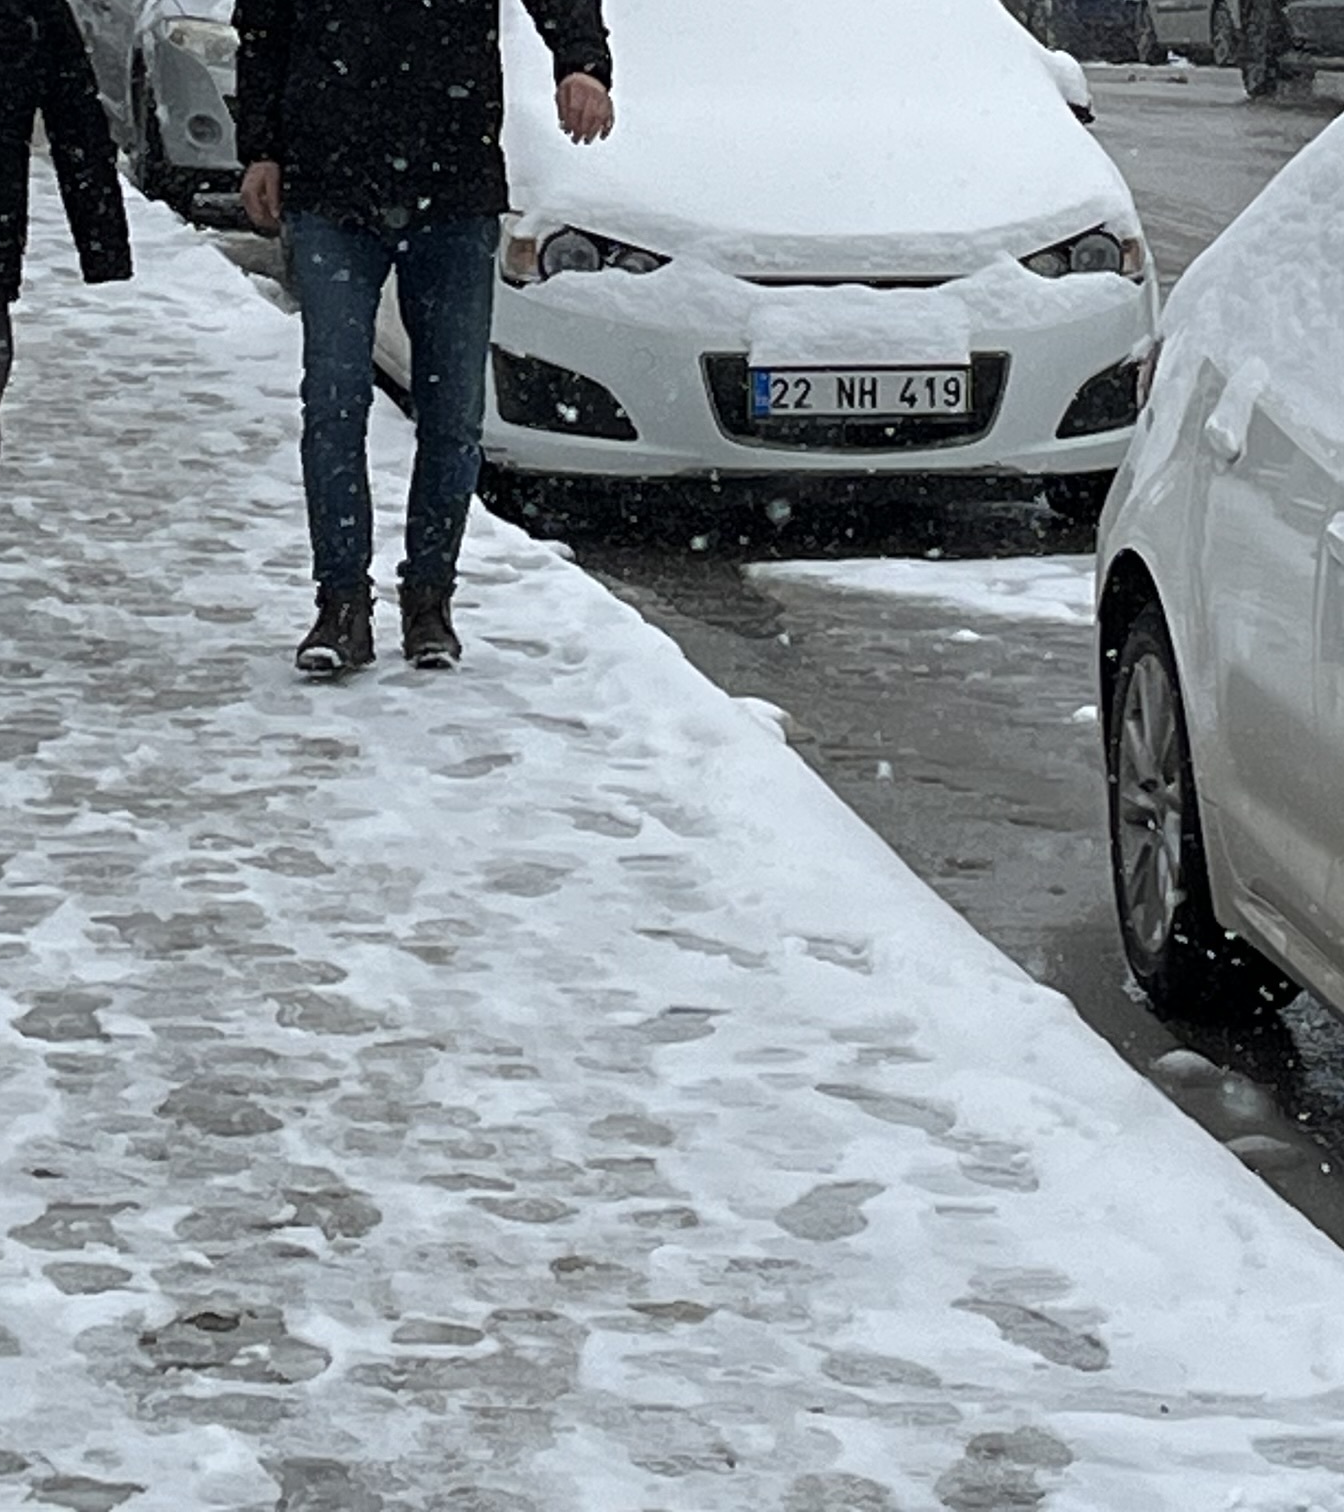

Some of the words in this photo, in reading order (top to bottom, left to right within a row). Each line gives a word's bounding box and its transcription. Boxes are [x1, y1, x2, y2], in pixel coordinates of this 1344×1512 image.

[771, 378, 812, 409] 22
[836, 377, 877, 408] NH
[899, 377, 960, 408] 419
